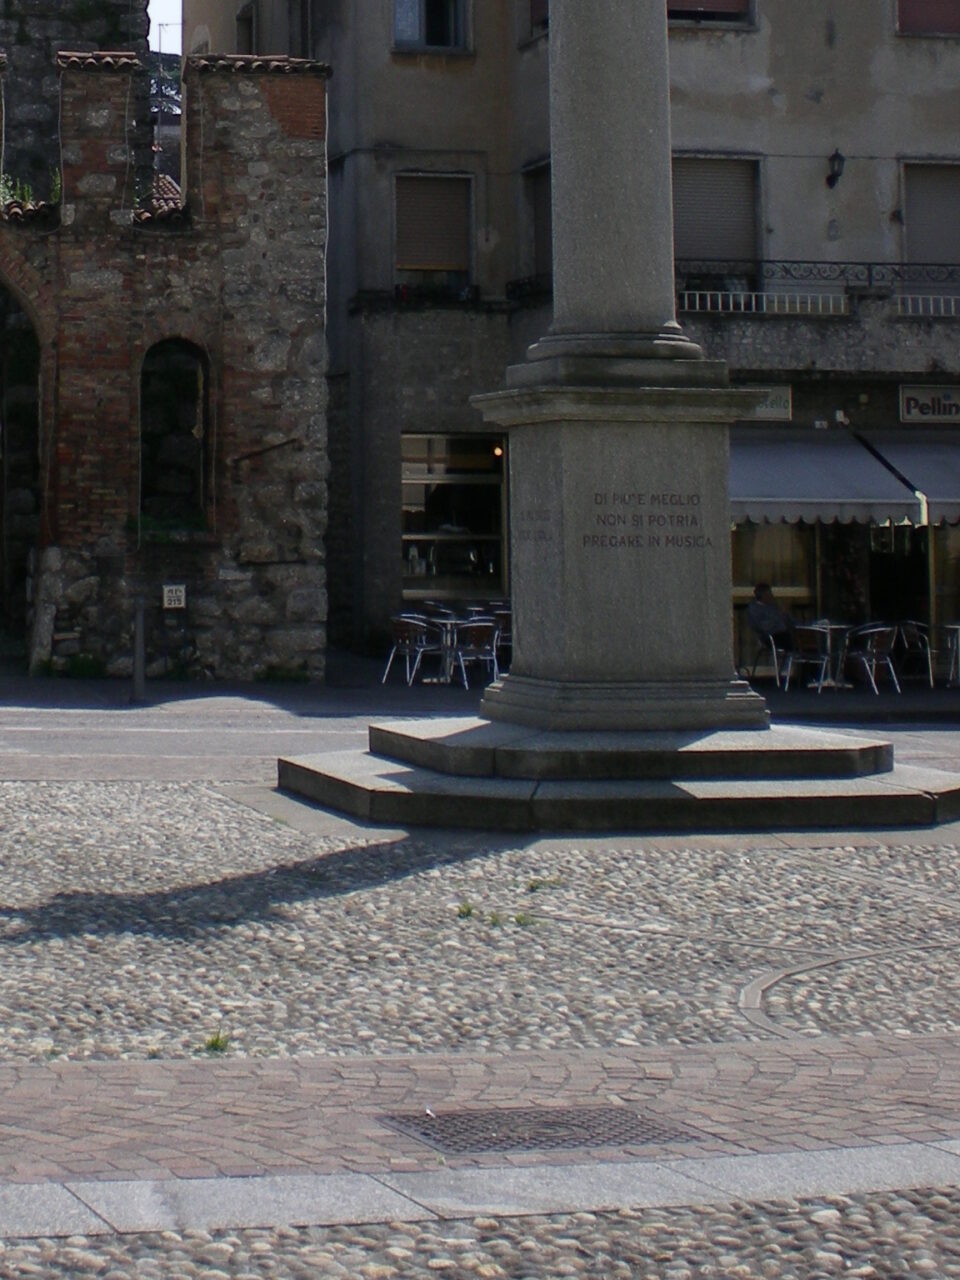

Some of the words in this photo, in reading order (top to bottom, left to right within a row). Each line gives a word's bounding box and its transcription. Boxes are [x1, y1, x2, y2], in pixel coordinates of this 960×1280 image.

[594, 492, 607, 505] DI
[650, 493, 701, 506] MEGLIO
[595, 513, 627, 527] NON
[631, 514, 644, 527] SI
[582, 534, 644, 548] PREGARE
[648, 535, 660, 548] IN
[665, 535, 714, 549] MUSICA
